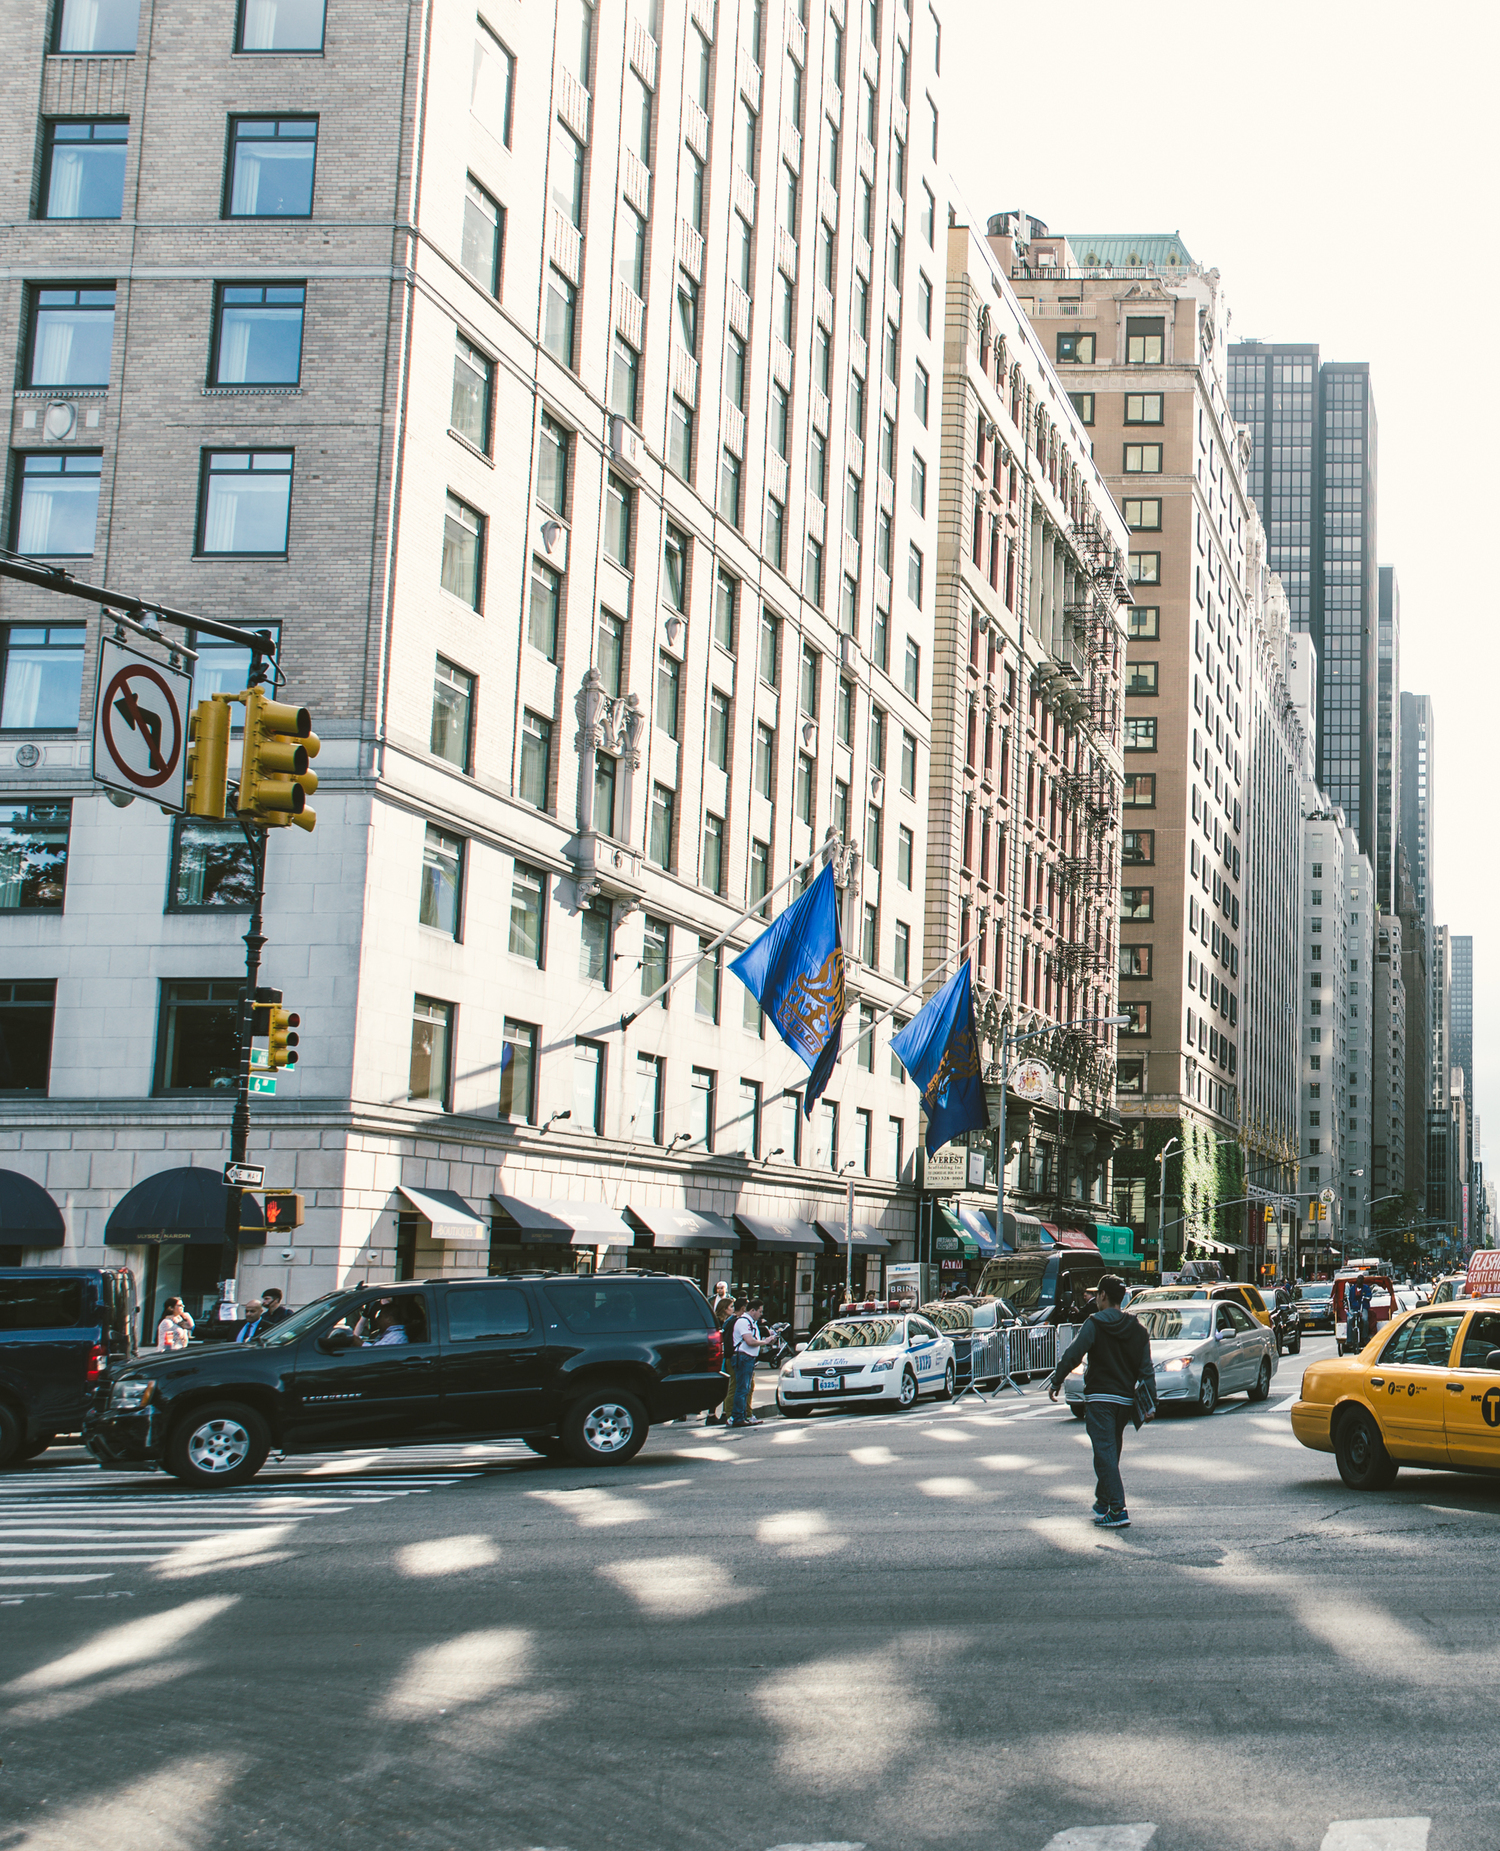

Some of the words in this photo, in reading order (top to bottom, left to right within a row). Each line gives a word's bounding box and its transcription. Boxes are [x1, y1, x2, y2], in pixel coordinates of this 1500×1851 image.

[254, 1079, 260, 1091] 6
[928, 1156, 964, 1164] EVEREST
[231, 1169, 242, 1179] ONE
[248, 1171, 260, 1181] WAY
[437, 1225, 473, 1237] BOUTIQUES
[943, 1260, 962, 1269] ATM
[890, 1285, 918, 1293] BRING
[1472, 1284, 1486, 1293] 52ND
[1487, 1285, 1492, 1293] &
[919, 1355, 932, 1371] NYPD
[1487, 1395, 1500, 1422] T
